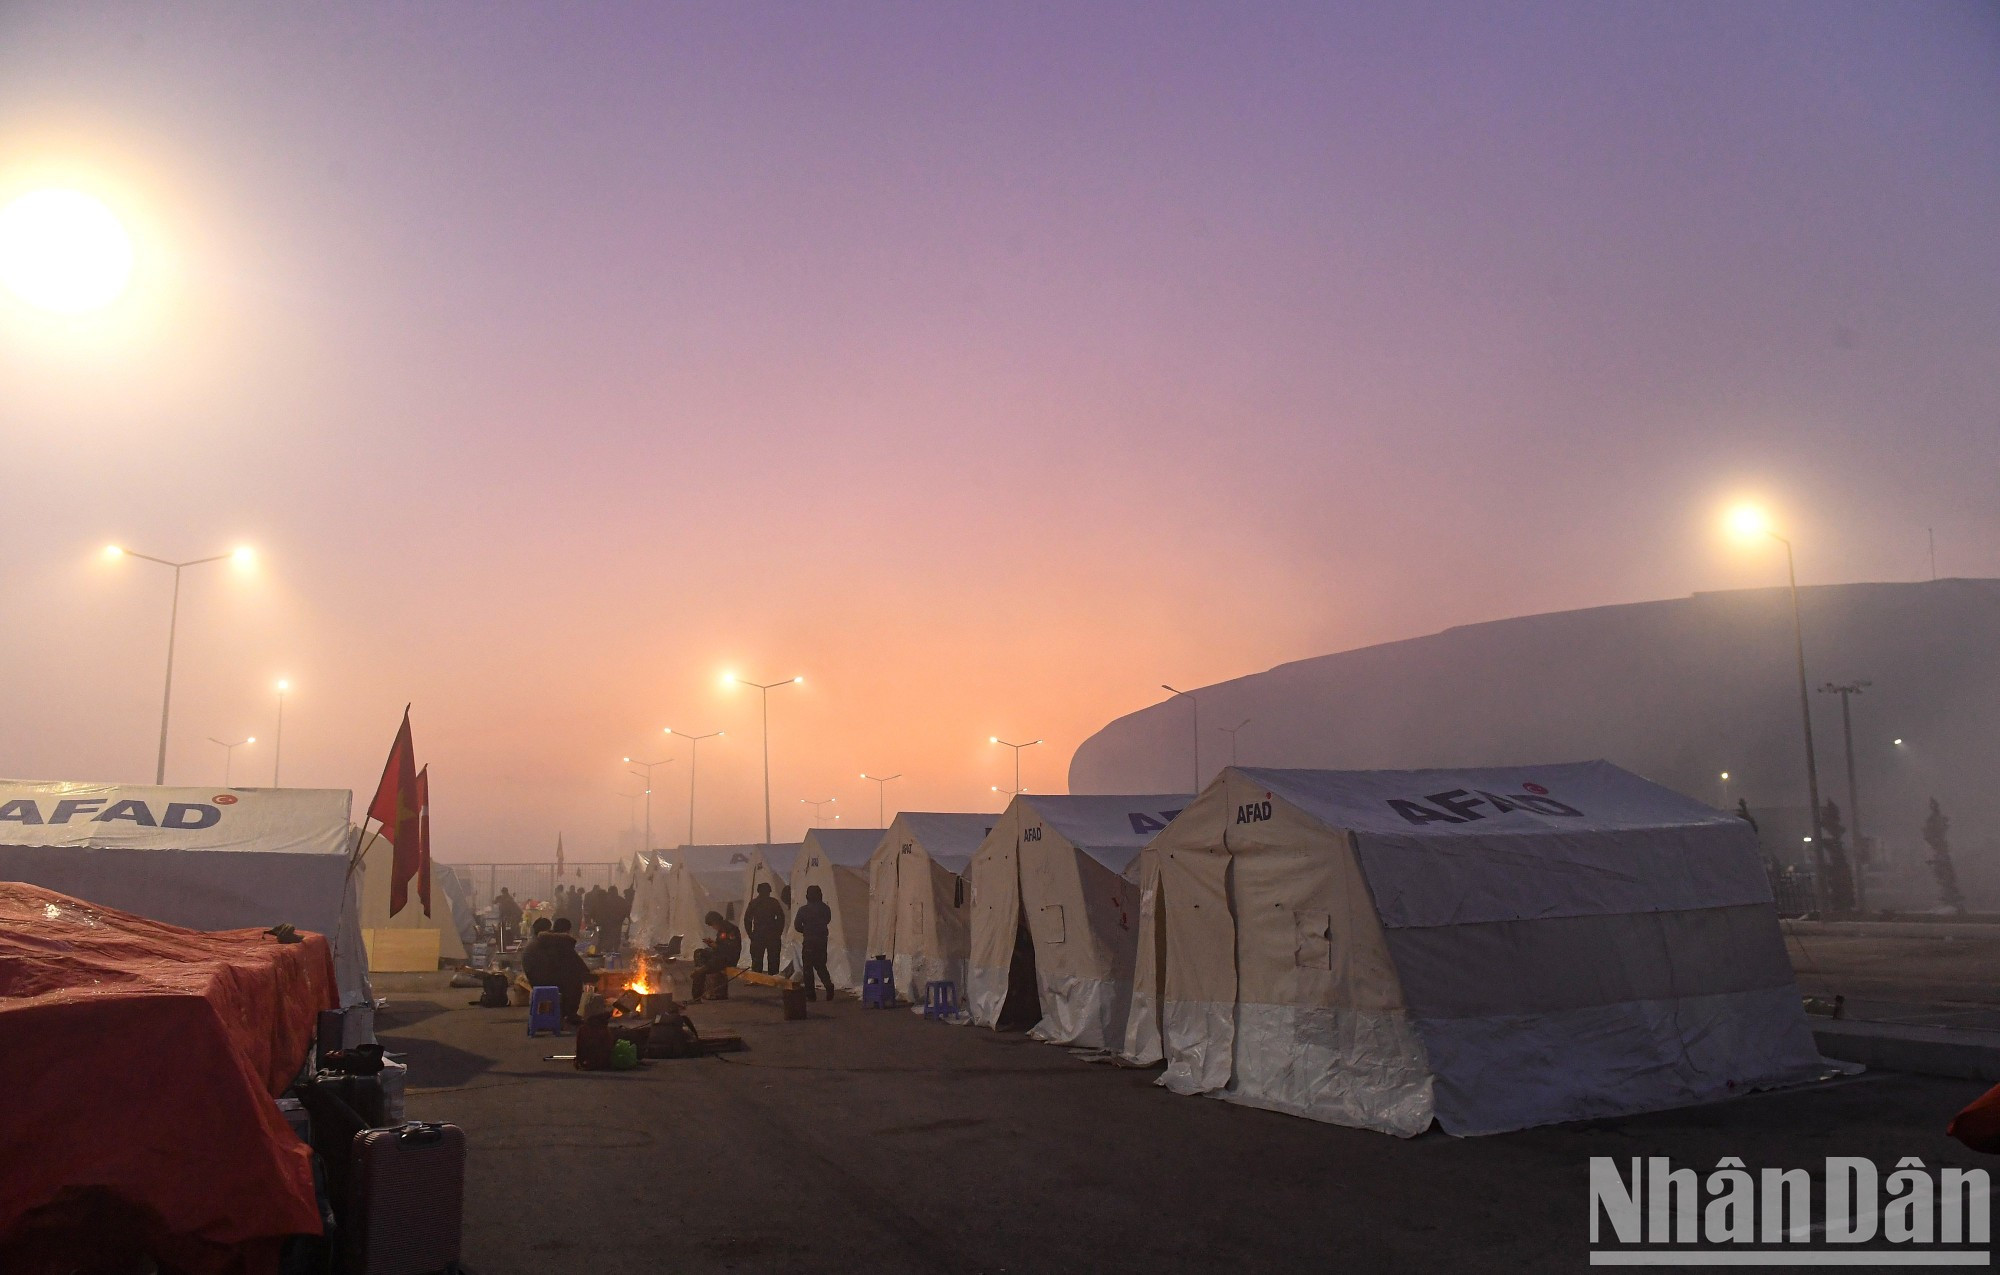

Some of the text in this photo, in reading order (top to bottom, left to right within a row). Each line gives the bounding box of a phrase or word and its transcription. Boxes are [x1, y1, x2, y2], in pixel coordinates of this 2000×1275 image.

[0, 798, 222, 830] AFAD
[1236, 801, 1273, 825] AFAD
[1387, 788, 1584, 825] AFAD
[1023, 827, 1042, 842] AFAD
